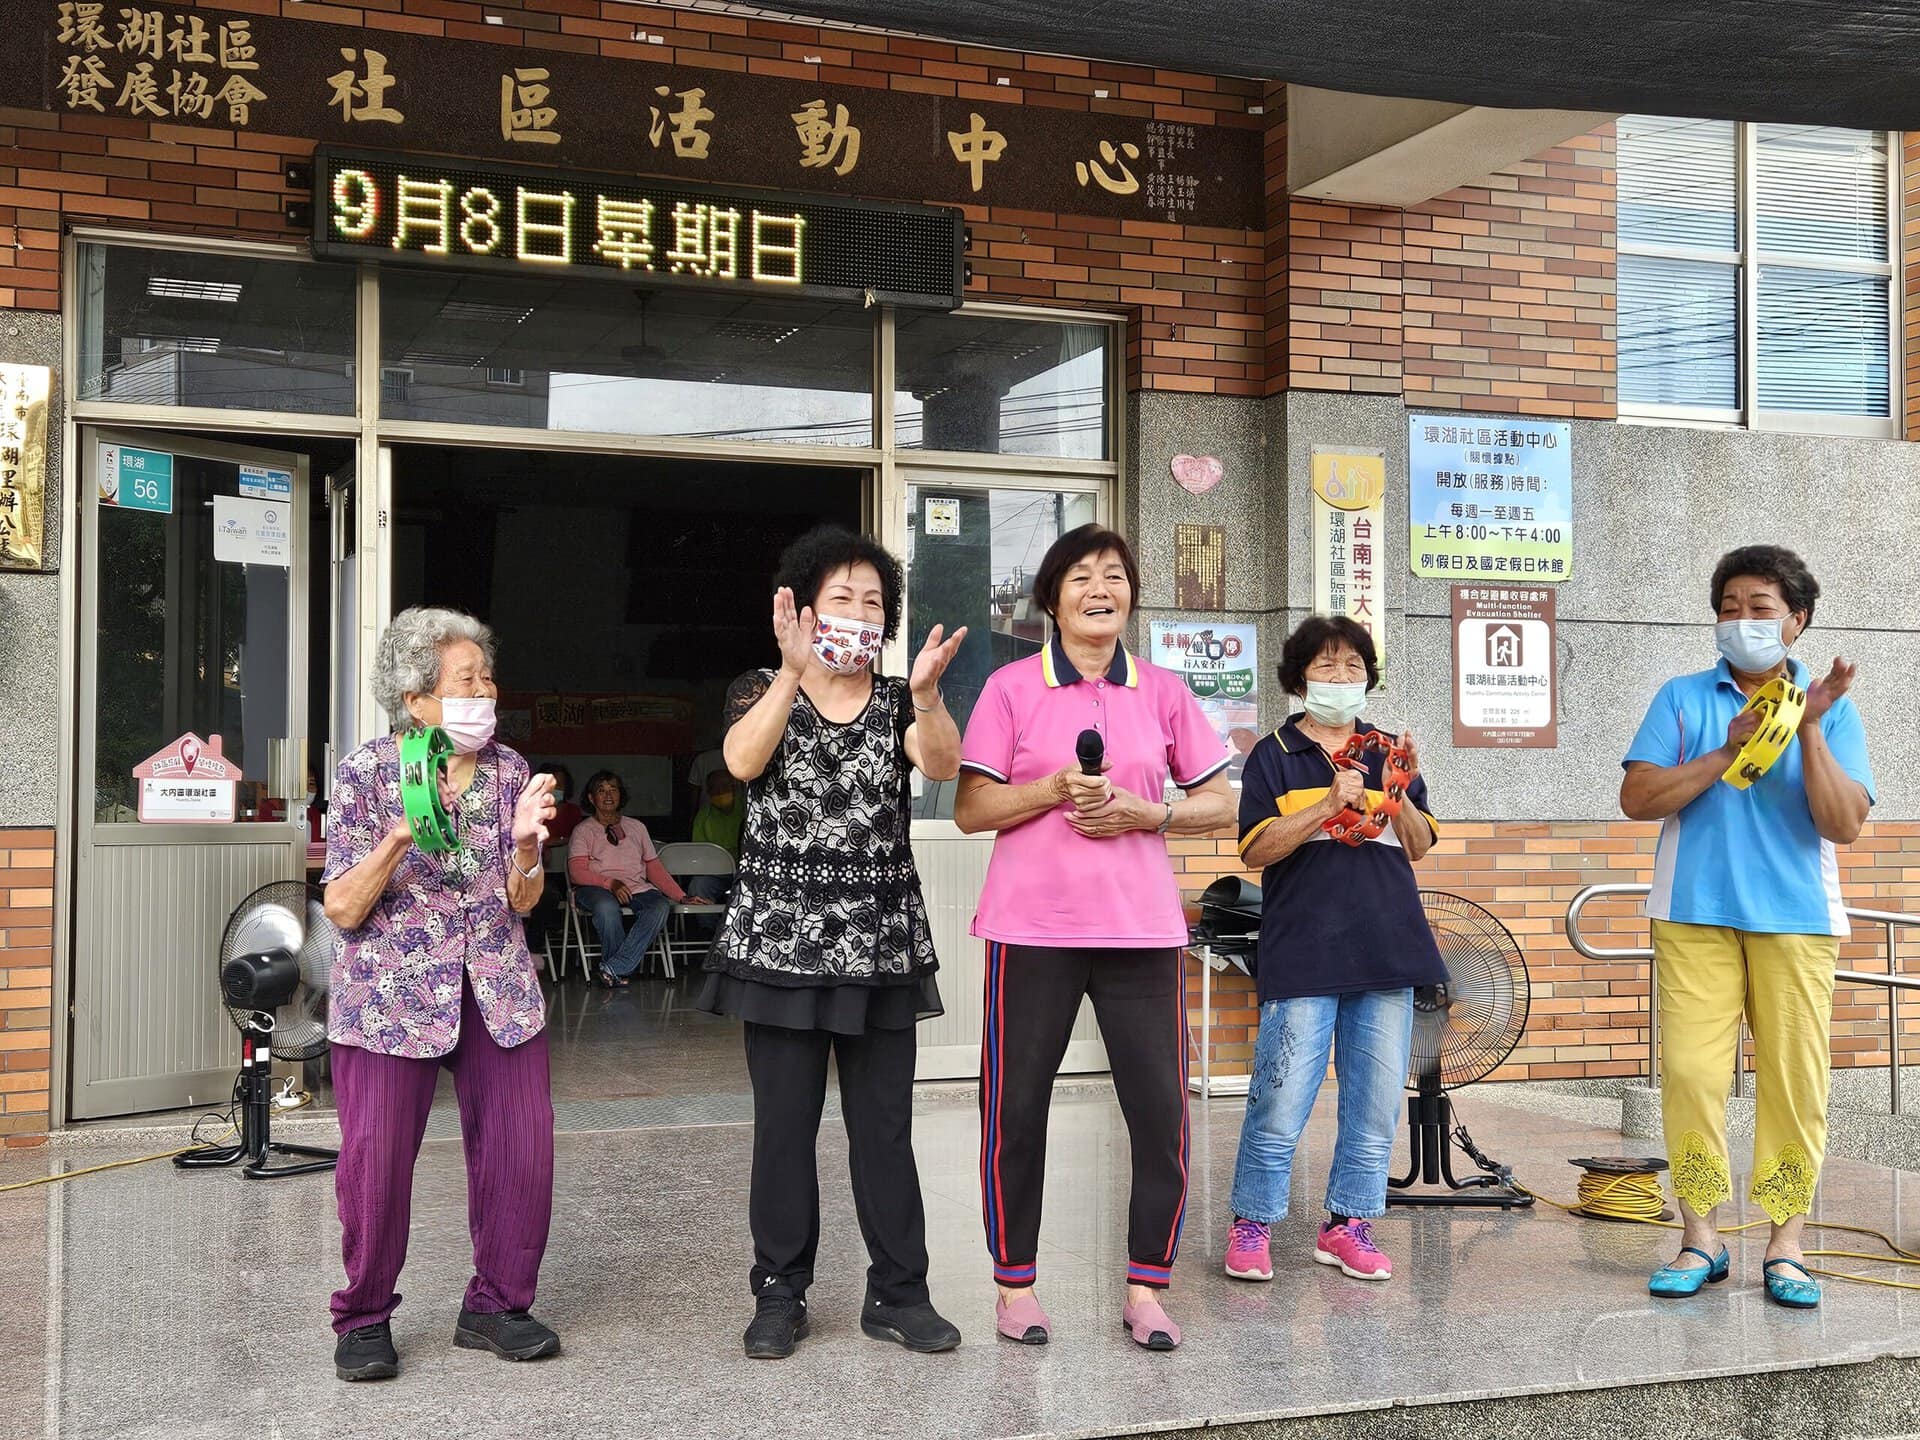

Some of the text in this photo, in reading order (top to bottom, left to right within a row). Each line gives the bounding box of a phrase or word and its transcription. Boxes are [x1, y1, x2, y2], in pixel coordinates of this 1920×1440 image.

[56, 1, 260, 71] 環湖社區
[56, 53, 268, 125] 發展協會
[326, 46, 1141, 196] 社區活動中心
[1424, 425, 1558, 449] 環湖社區活動中心
[1464, 451, 1520, 467] (關懷據點)
[134, 478, 158, 500] 56
[1436, 471, 1548, 493] 開放(服務)時間:
[1450, 503, 1535, 521] 每週一至週五
[1420, 553, 1564, 574] 例假日及國定假日休館
[1466, 609, 1541, 618] Evacuation Shelter
[1476, 602, 1532, 610] Multi-function
[1184, 659, 1226, 670] 行人安全行
[1465, 674, 1548, 687] 環湖社區活動中心
